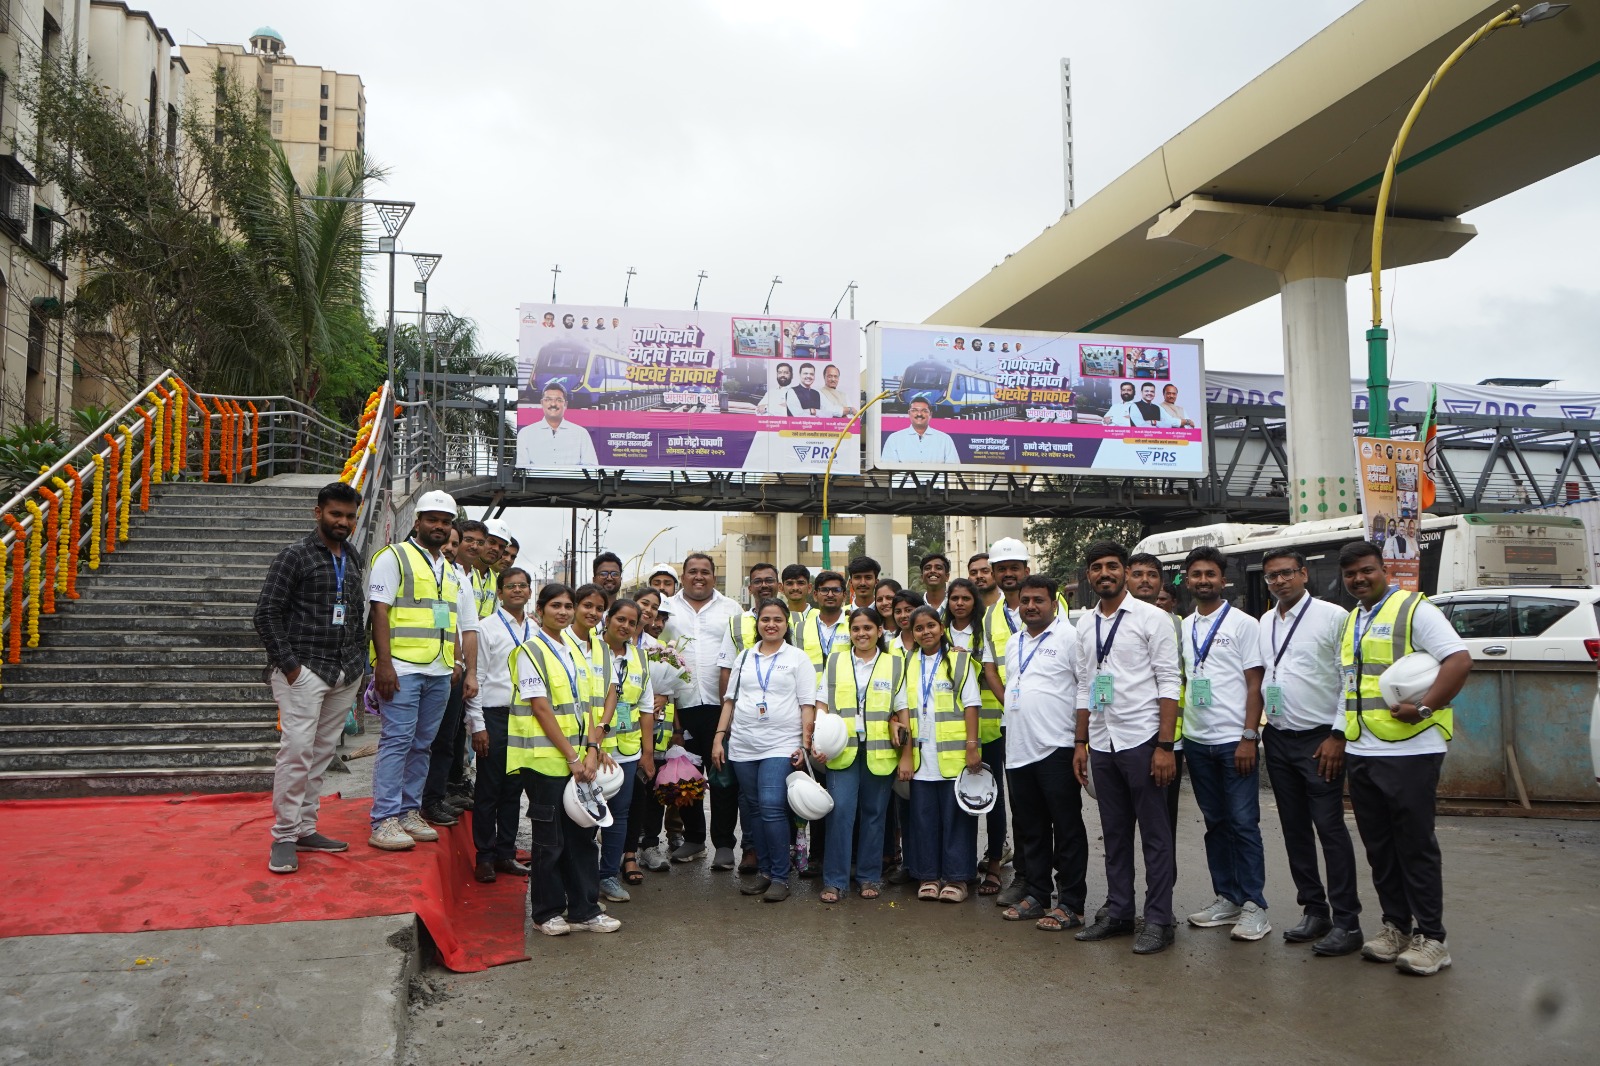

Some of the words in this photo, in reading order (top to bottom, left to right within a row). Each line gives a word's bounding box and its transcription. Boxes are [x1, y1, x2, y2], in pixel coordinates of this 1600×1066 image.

[628, 343, 669, 365] मेट्रोचे
[670, 348, 710, 364] स्वप्न
[625, 362, 668, 382] अखेर
[669, 367, 719, 384] साकार
[1031, 375, 1065, 388] स्वप्न
[994, 386, 1030, 401] अखेर
[1031, 390, 1072, 403] साकार
[667, 436, 683, 447] ठाणे
[684, 436, 700, 448] मेट्रो
[1023, 442, 1037, 451] ठाणे
[1038, 442, 1052, 452] मेट्रो
[811, 446, 838, 459] PRS
[1153, 451, 1176, 462] PRS
[1421, 532, 1441, 541] SSION
[372, 584, 385, 592] PRS
[1044, 648, 1057, 656] PRS
